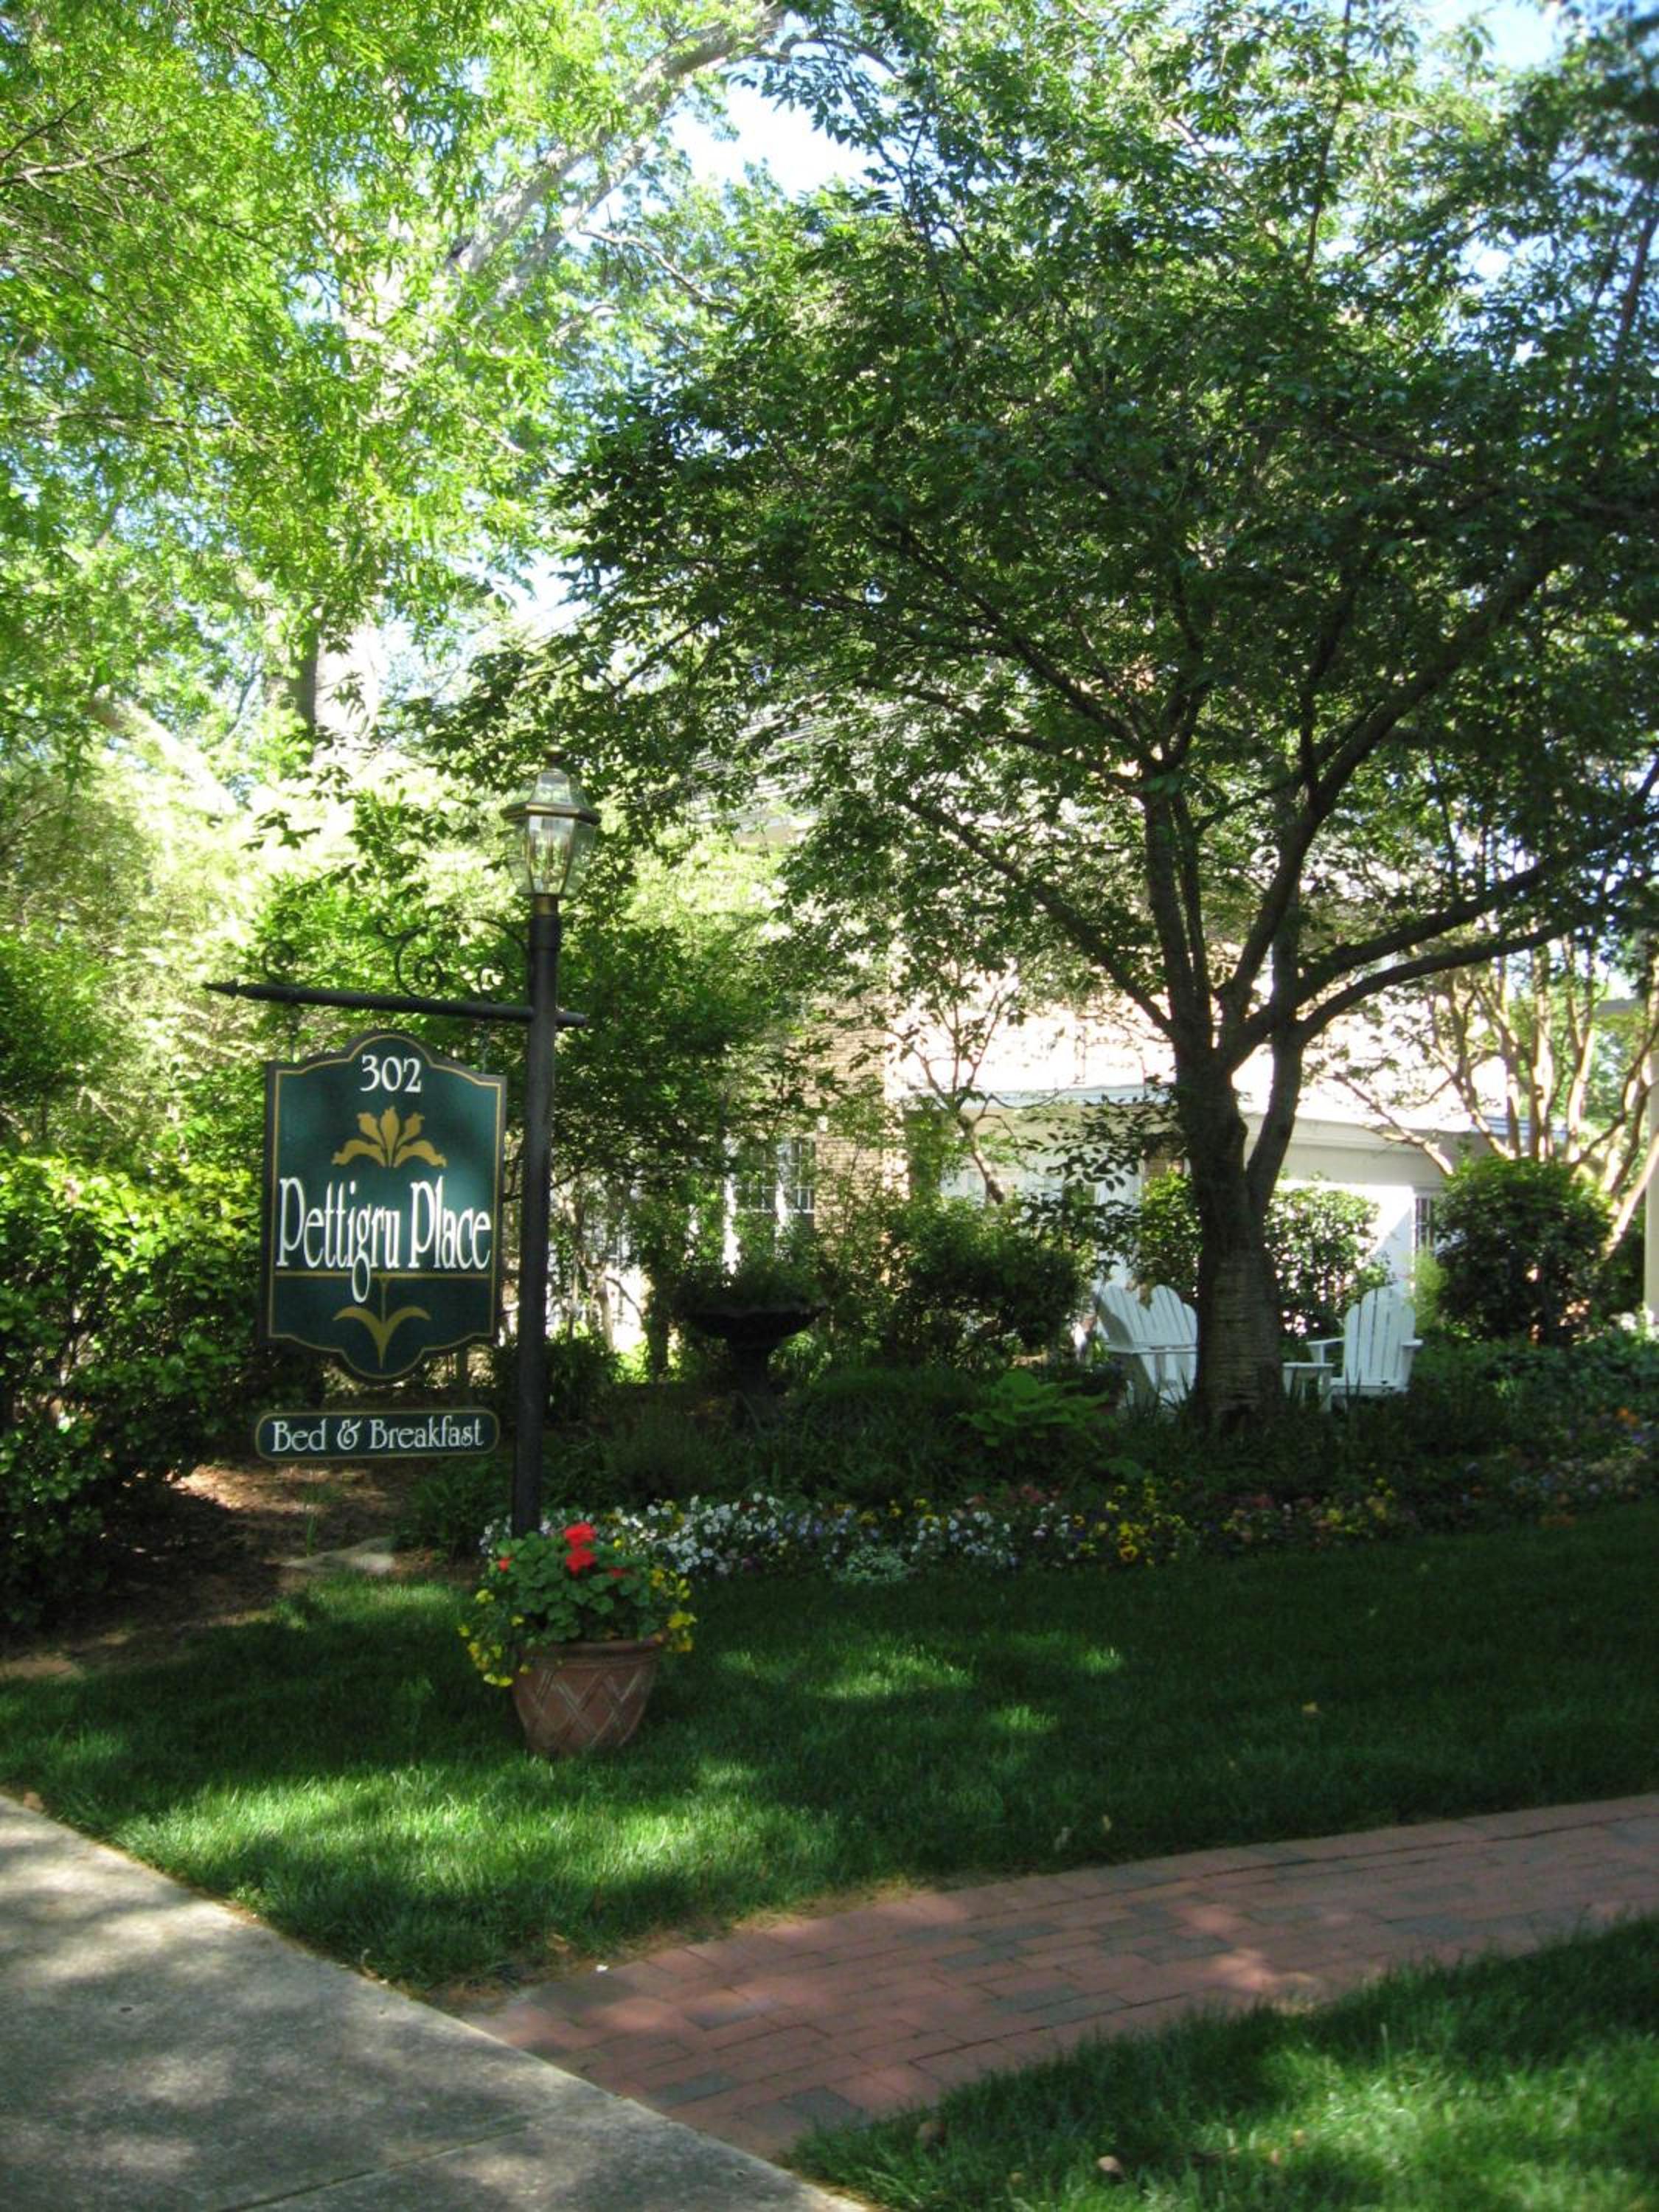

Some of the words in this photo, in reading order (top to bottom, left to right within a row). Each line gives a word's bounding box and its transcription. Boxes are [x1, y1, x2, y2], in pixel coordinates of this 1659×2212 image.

[360, 1054, 422, 1093] 302
[276, 1177, 400, 1304] Pettigru
[408, 1175, 491, 1270] Place
[272, 1418, 325, 1453] Bed
[336, 1419, 362, 1450] &
[369, 1415, 484, 1450] Breakfast
